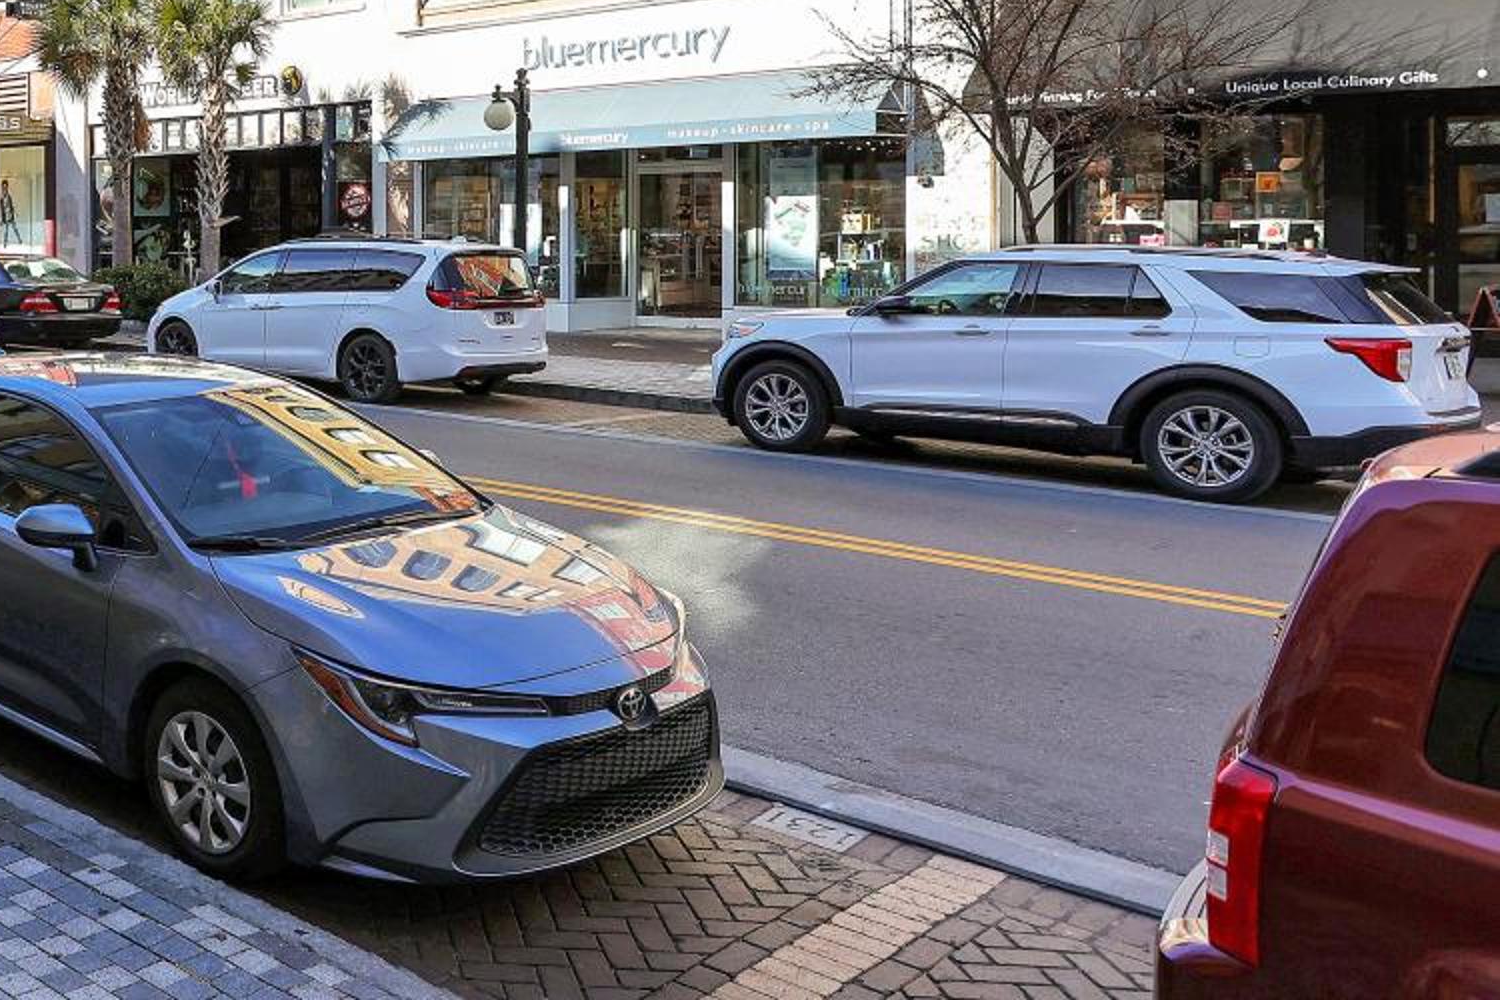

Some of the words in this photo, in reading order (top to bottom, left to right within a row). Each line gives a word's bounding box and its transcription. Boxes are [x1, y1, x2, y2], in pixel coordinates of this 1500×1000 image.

[523, 25, 731, 71] bluemercury
[1225, 80, 1279, 94] Unique
[1283, 76, 1323, 90] Local
[1327, 73, 1395, 88] Culinary
[1399, 70, 1439, 84] Gifts
[667, 126, 719, 139] makeup
[730, 122, 792, 135] skincare
[803, 120, 830, 132] spa
